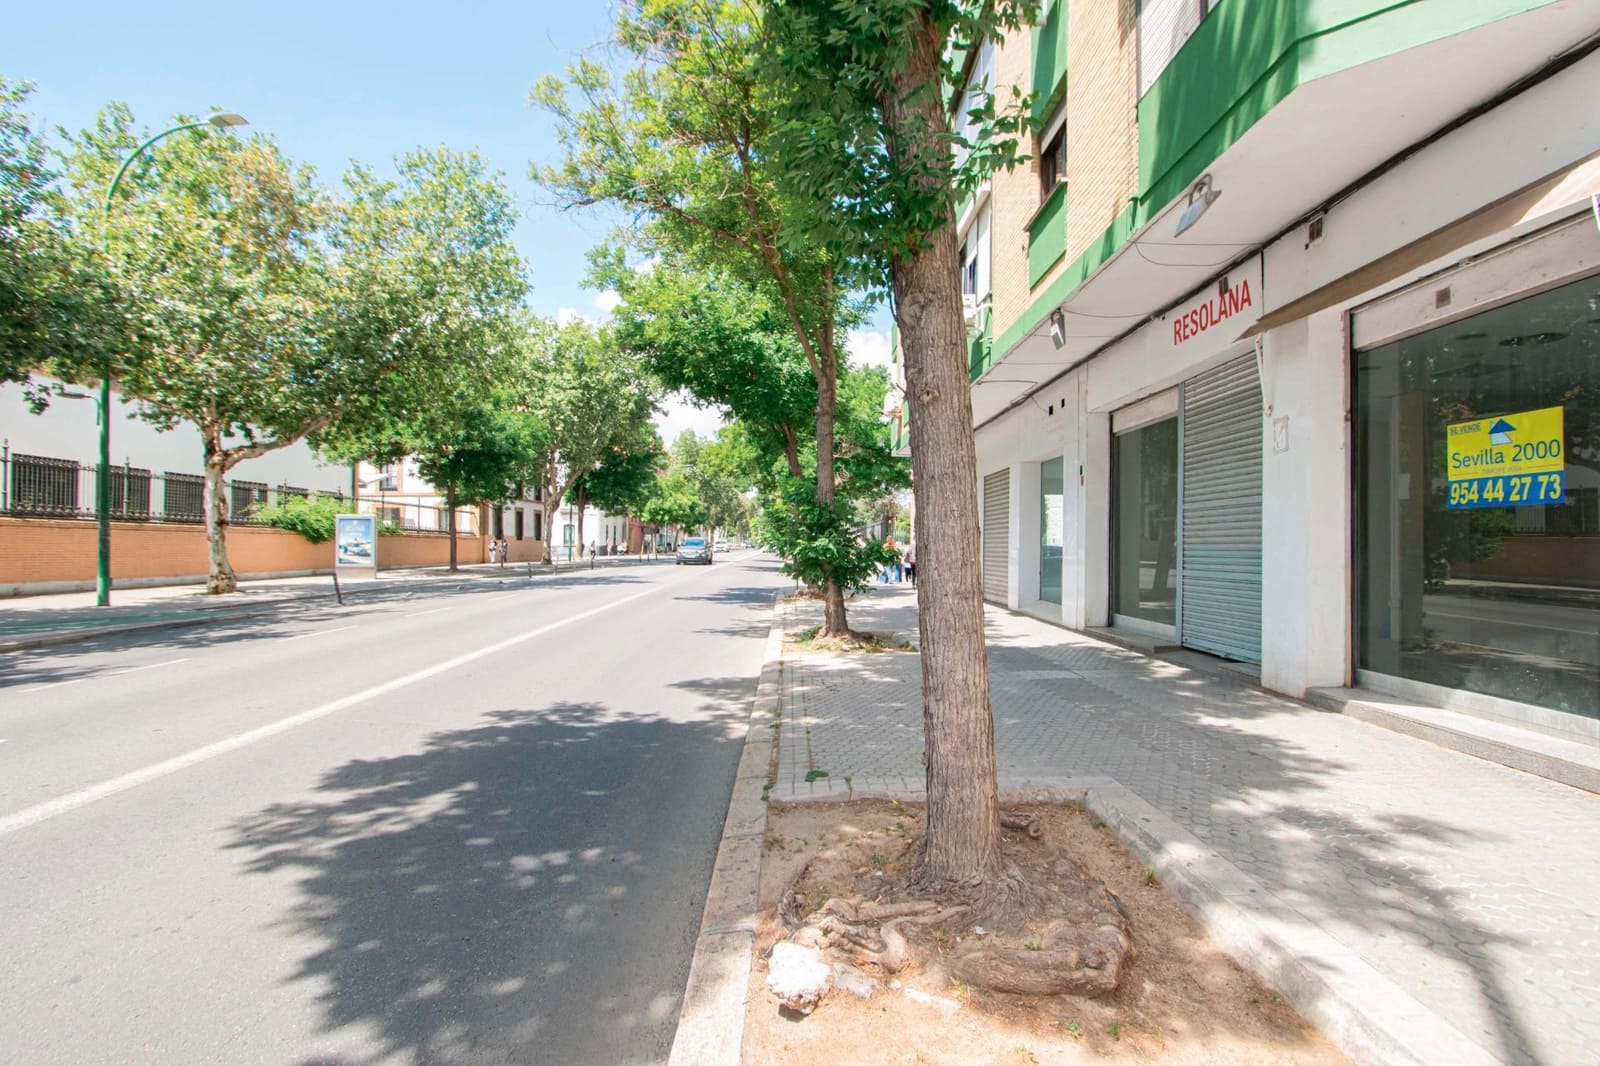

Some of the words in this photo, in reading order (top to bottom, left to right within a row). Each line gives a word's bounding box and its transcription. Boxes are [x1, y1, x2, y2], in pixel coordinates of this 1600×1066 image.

[1174, 279, 1251, 345] RESOLANA
[1460, 423, 1481, 434] VENDE
[1452, 448, 1504, 469] Sevilla
[1512, 439, 1561, 462] 2000
[1450, 481, 1479, 505] 954
[1483, 478, 1505, 502] 44
[1509, 476, 1532, 501] 27
[1537, 474, 1561, 500] 73
